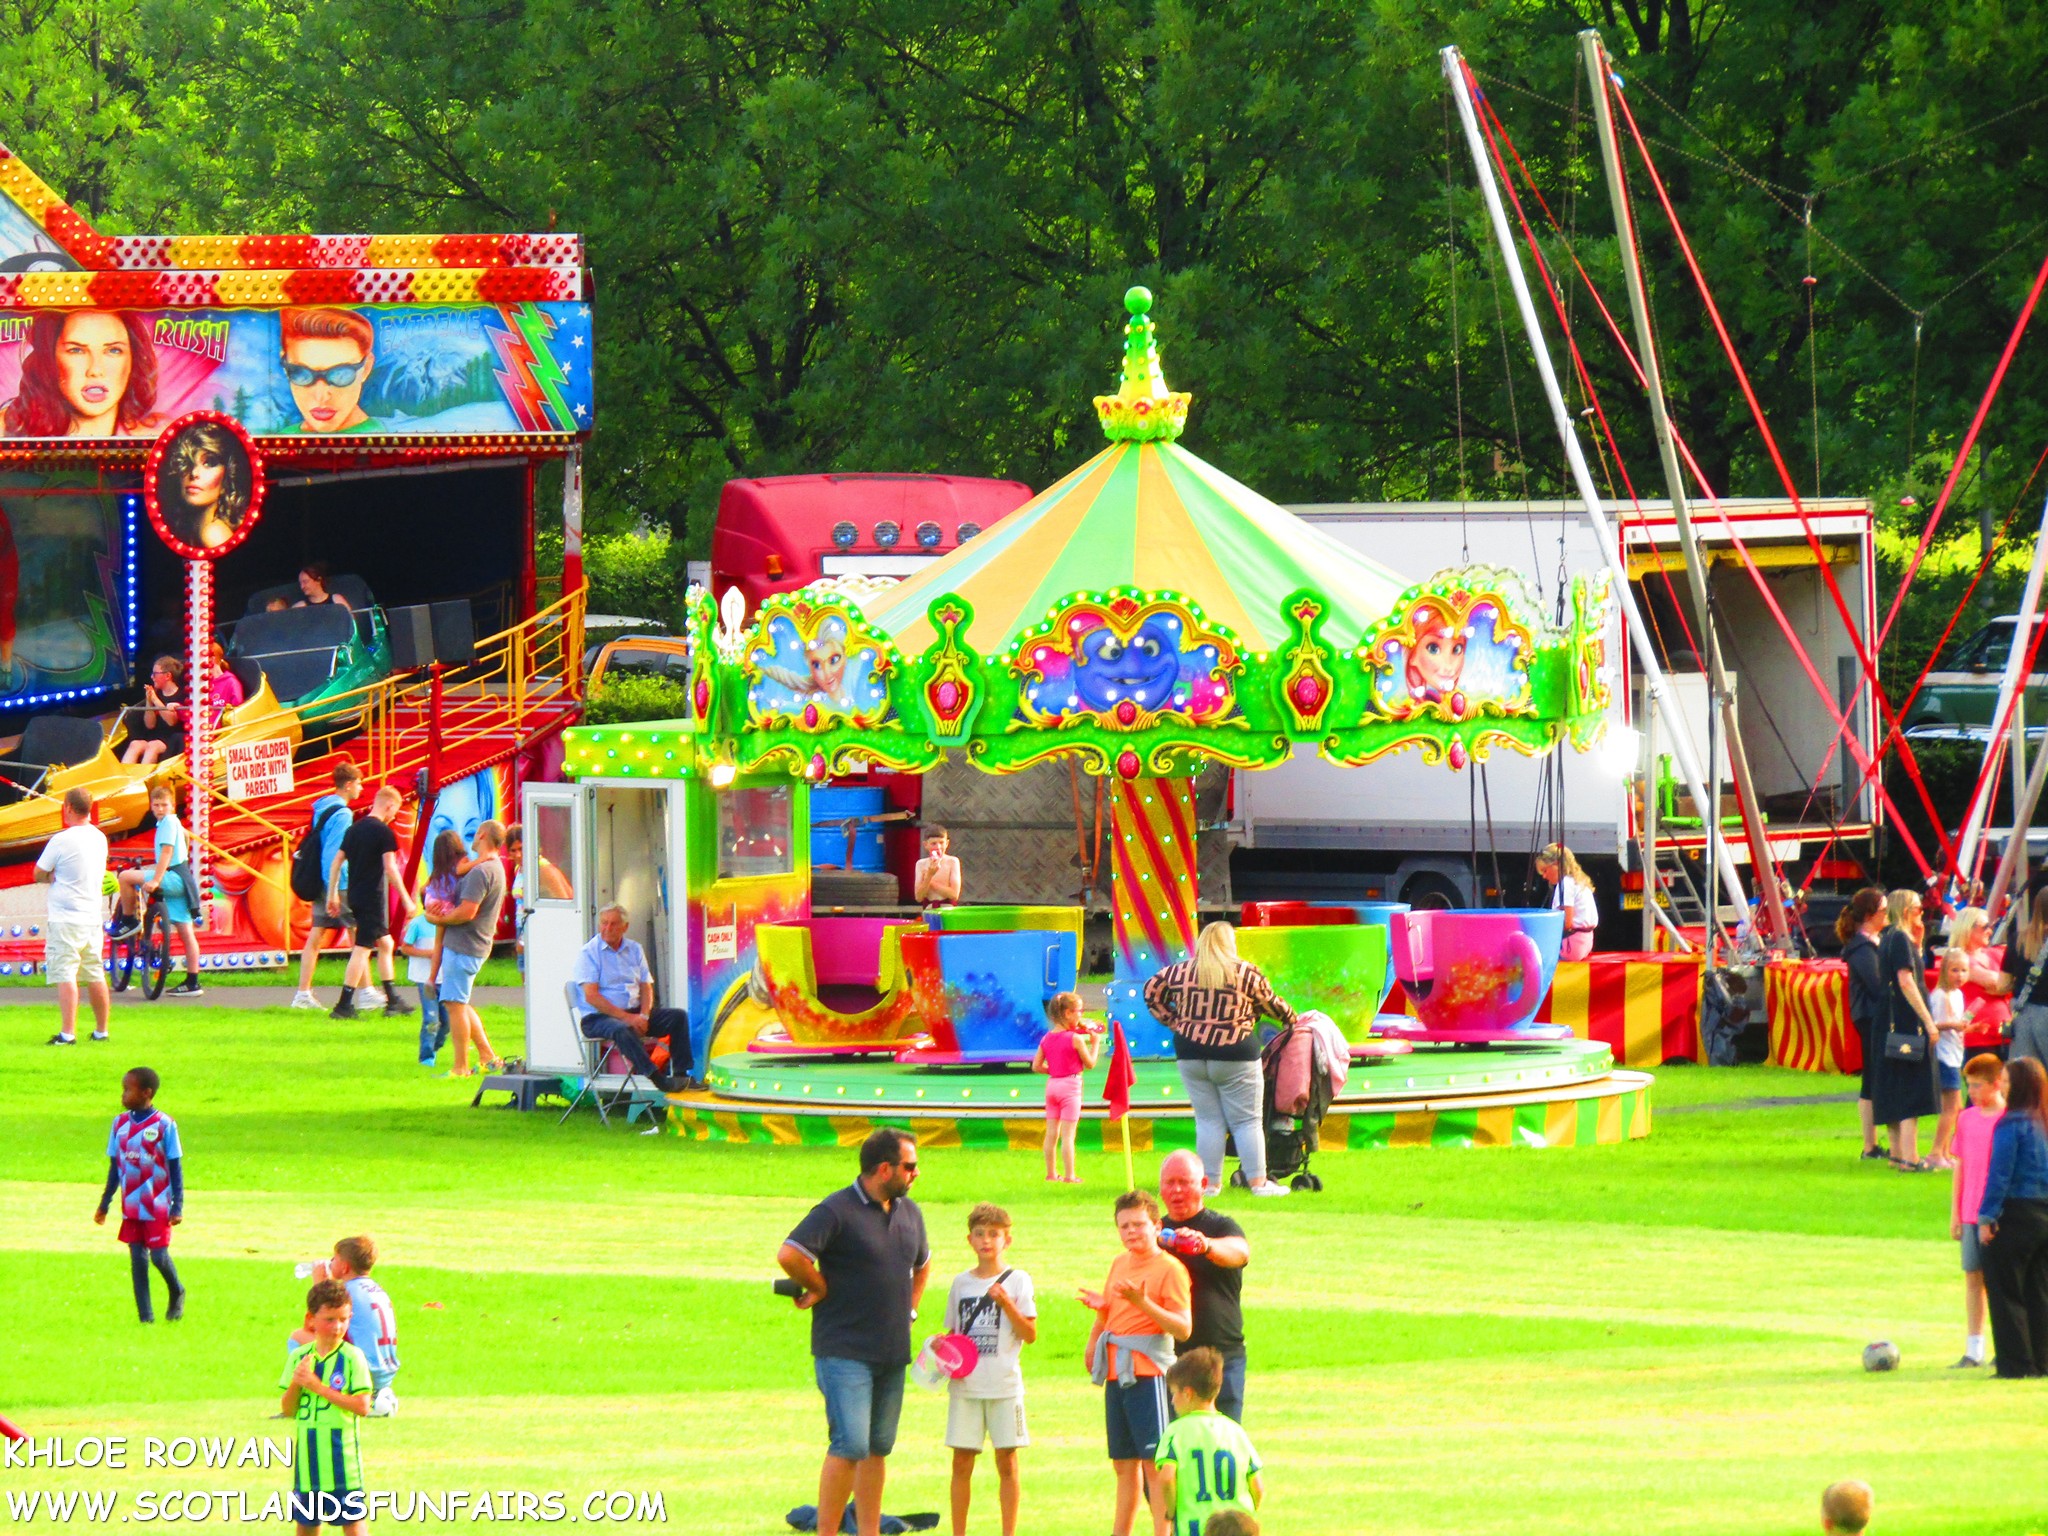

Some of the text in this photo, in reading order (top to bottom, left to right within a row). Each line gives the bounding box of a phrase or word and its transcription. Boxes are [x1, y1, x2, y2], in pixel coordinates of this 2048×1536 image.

[154, 319, 229, 362] RUSH
[380, 309, 481, 355] EXTREME
[229, 741, 289, 764] SMALL CHILDREN
[232, 759, 287, 781] CAN RIDE WITH
[245, 778, 278, 797] PARENTS
[707, 932, 733, 944] CASH ONLY
[1191, 1449, 1236, 1502] 10
